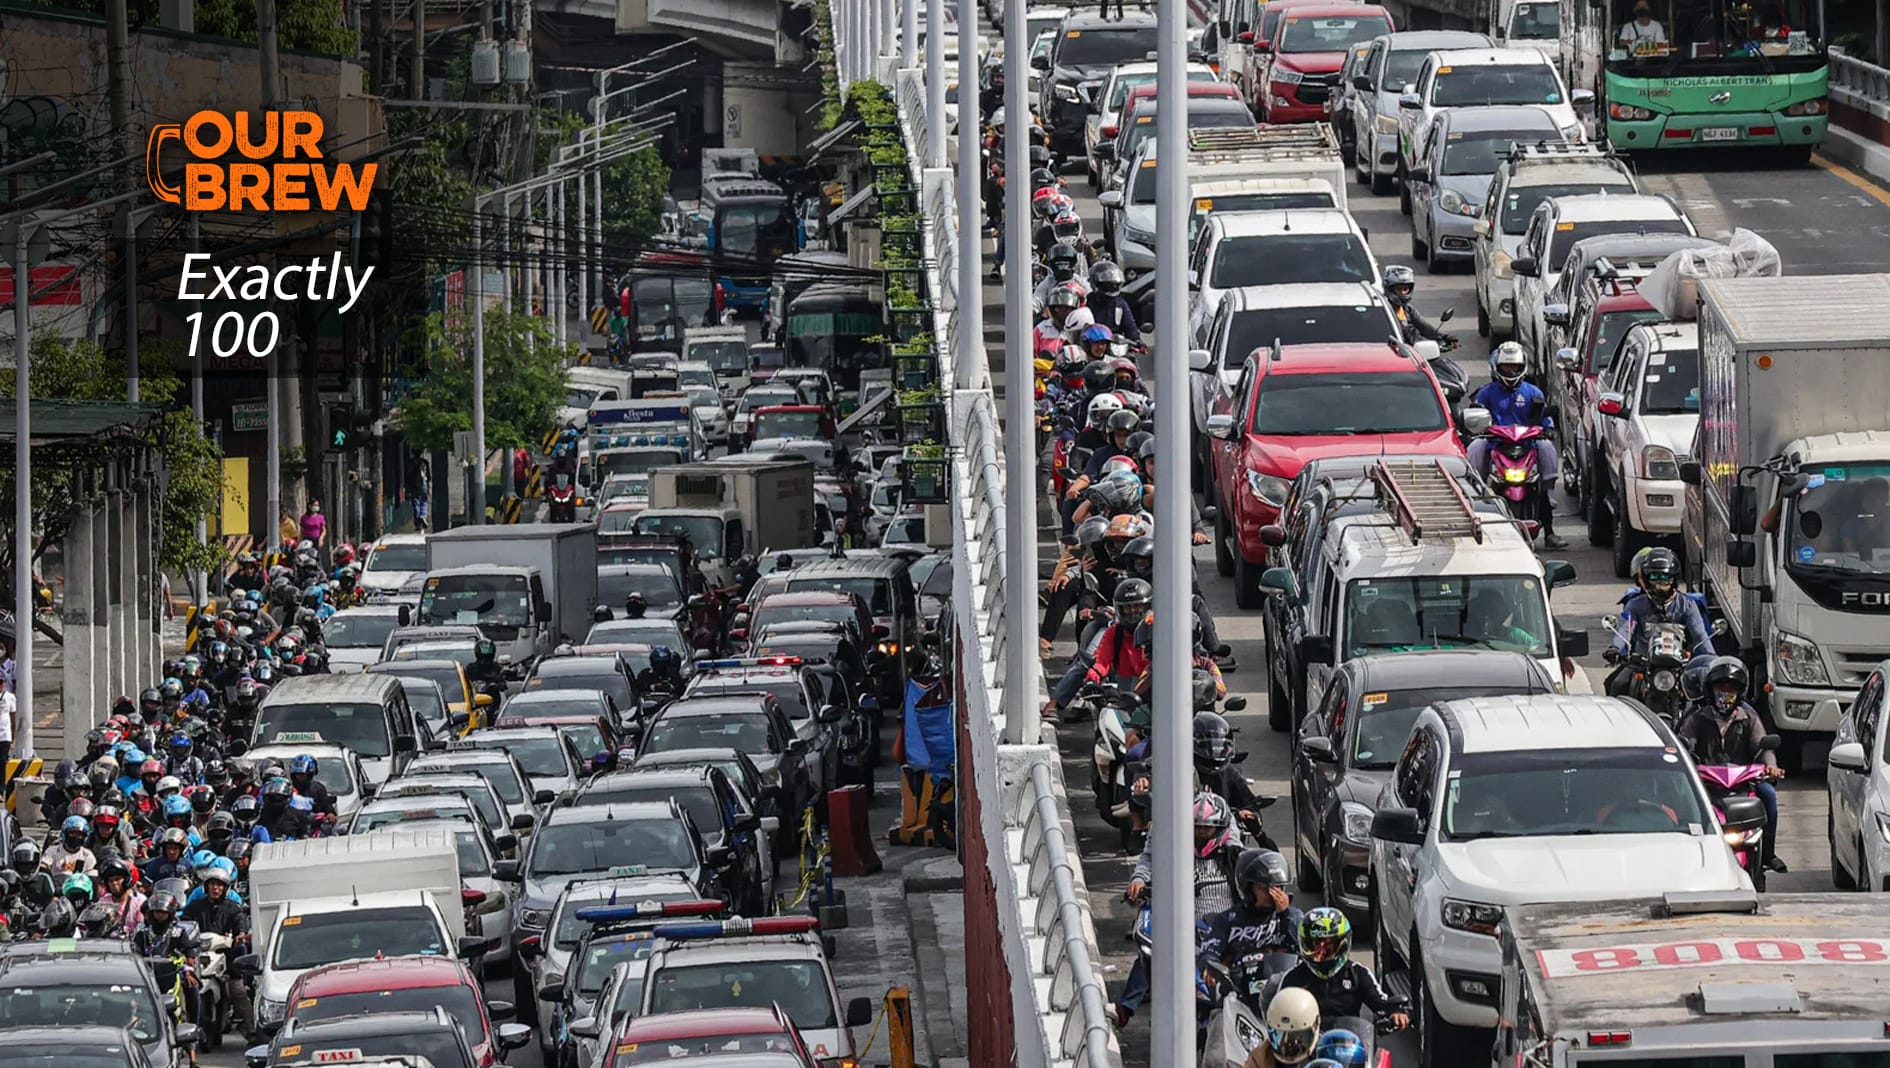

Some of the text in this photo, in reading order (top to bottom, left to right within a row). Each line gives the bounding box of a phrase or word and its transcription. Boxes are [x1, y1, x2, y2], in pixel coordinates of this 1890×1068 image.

[1663, 78, 1707, 87] NICHOLAS
[1710, 78, 1742, 86] ALBERT
[1571, 940, 1889, 971] 8008
[318, 1051, 354, 1062] TAXI
